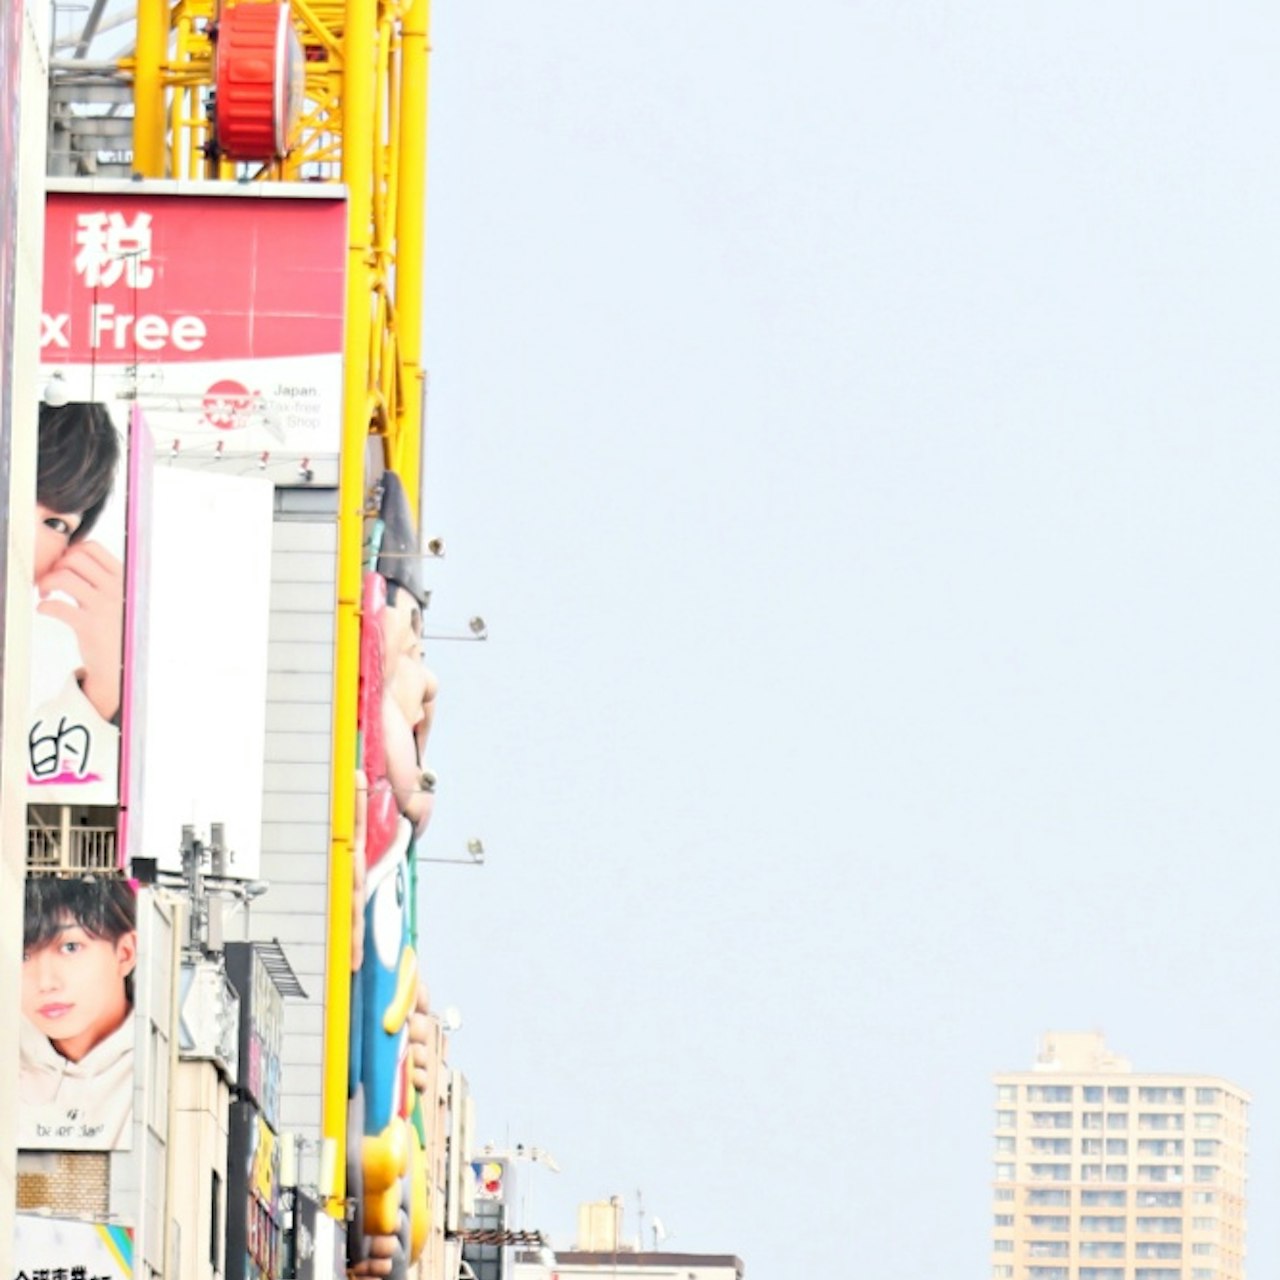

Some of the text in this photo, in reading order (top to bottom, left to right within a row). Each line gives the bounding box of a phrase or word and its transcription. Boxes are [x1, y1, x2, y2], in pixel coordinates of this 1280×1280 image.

[75, 211, 155, 289] 税
[91, 305, 207, 351] Free
[27, 716, 91, 777] 的
